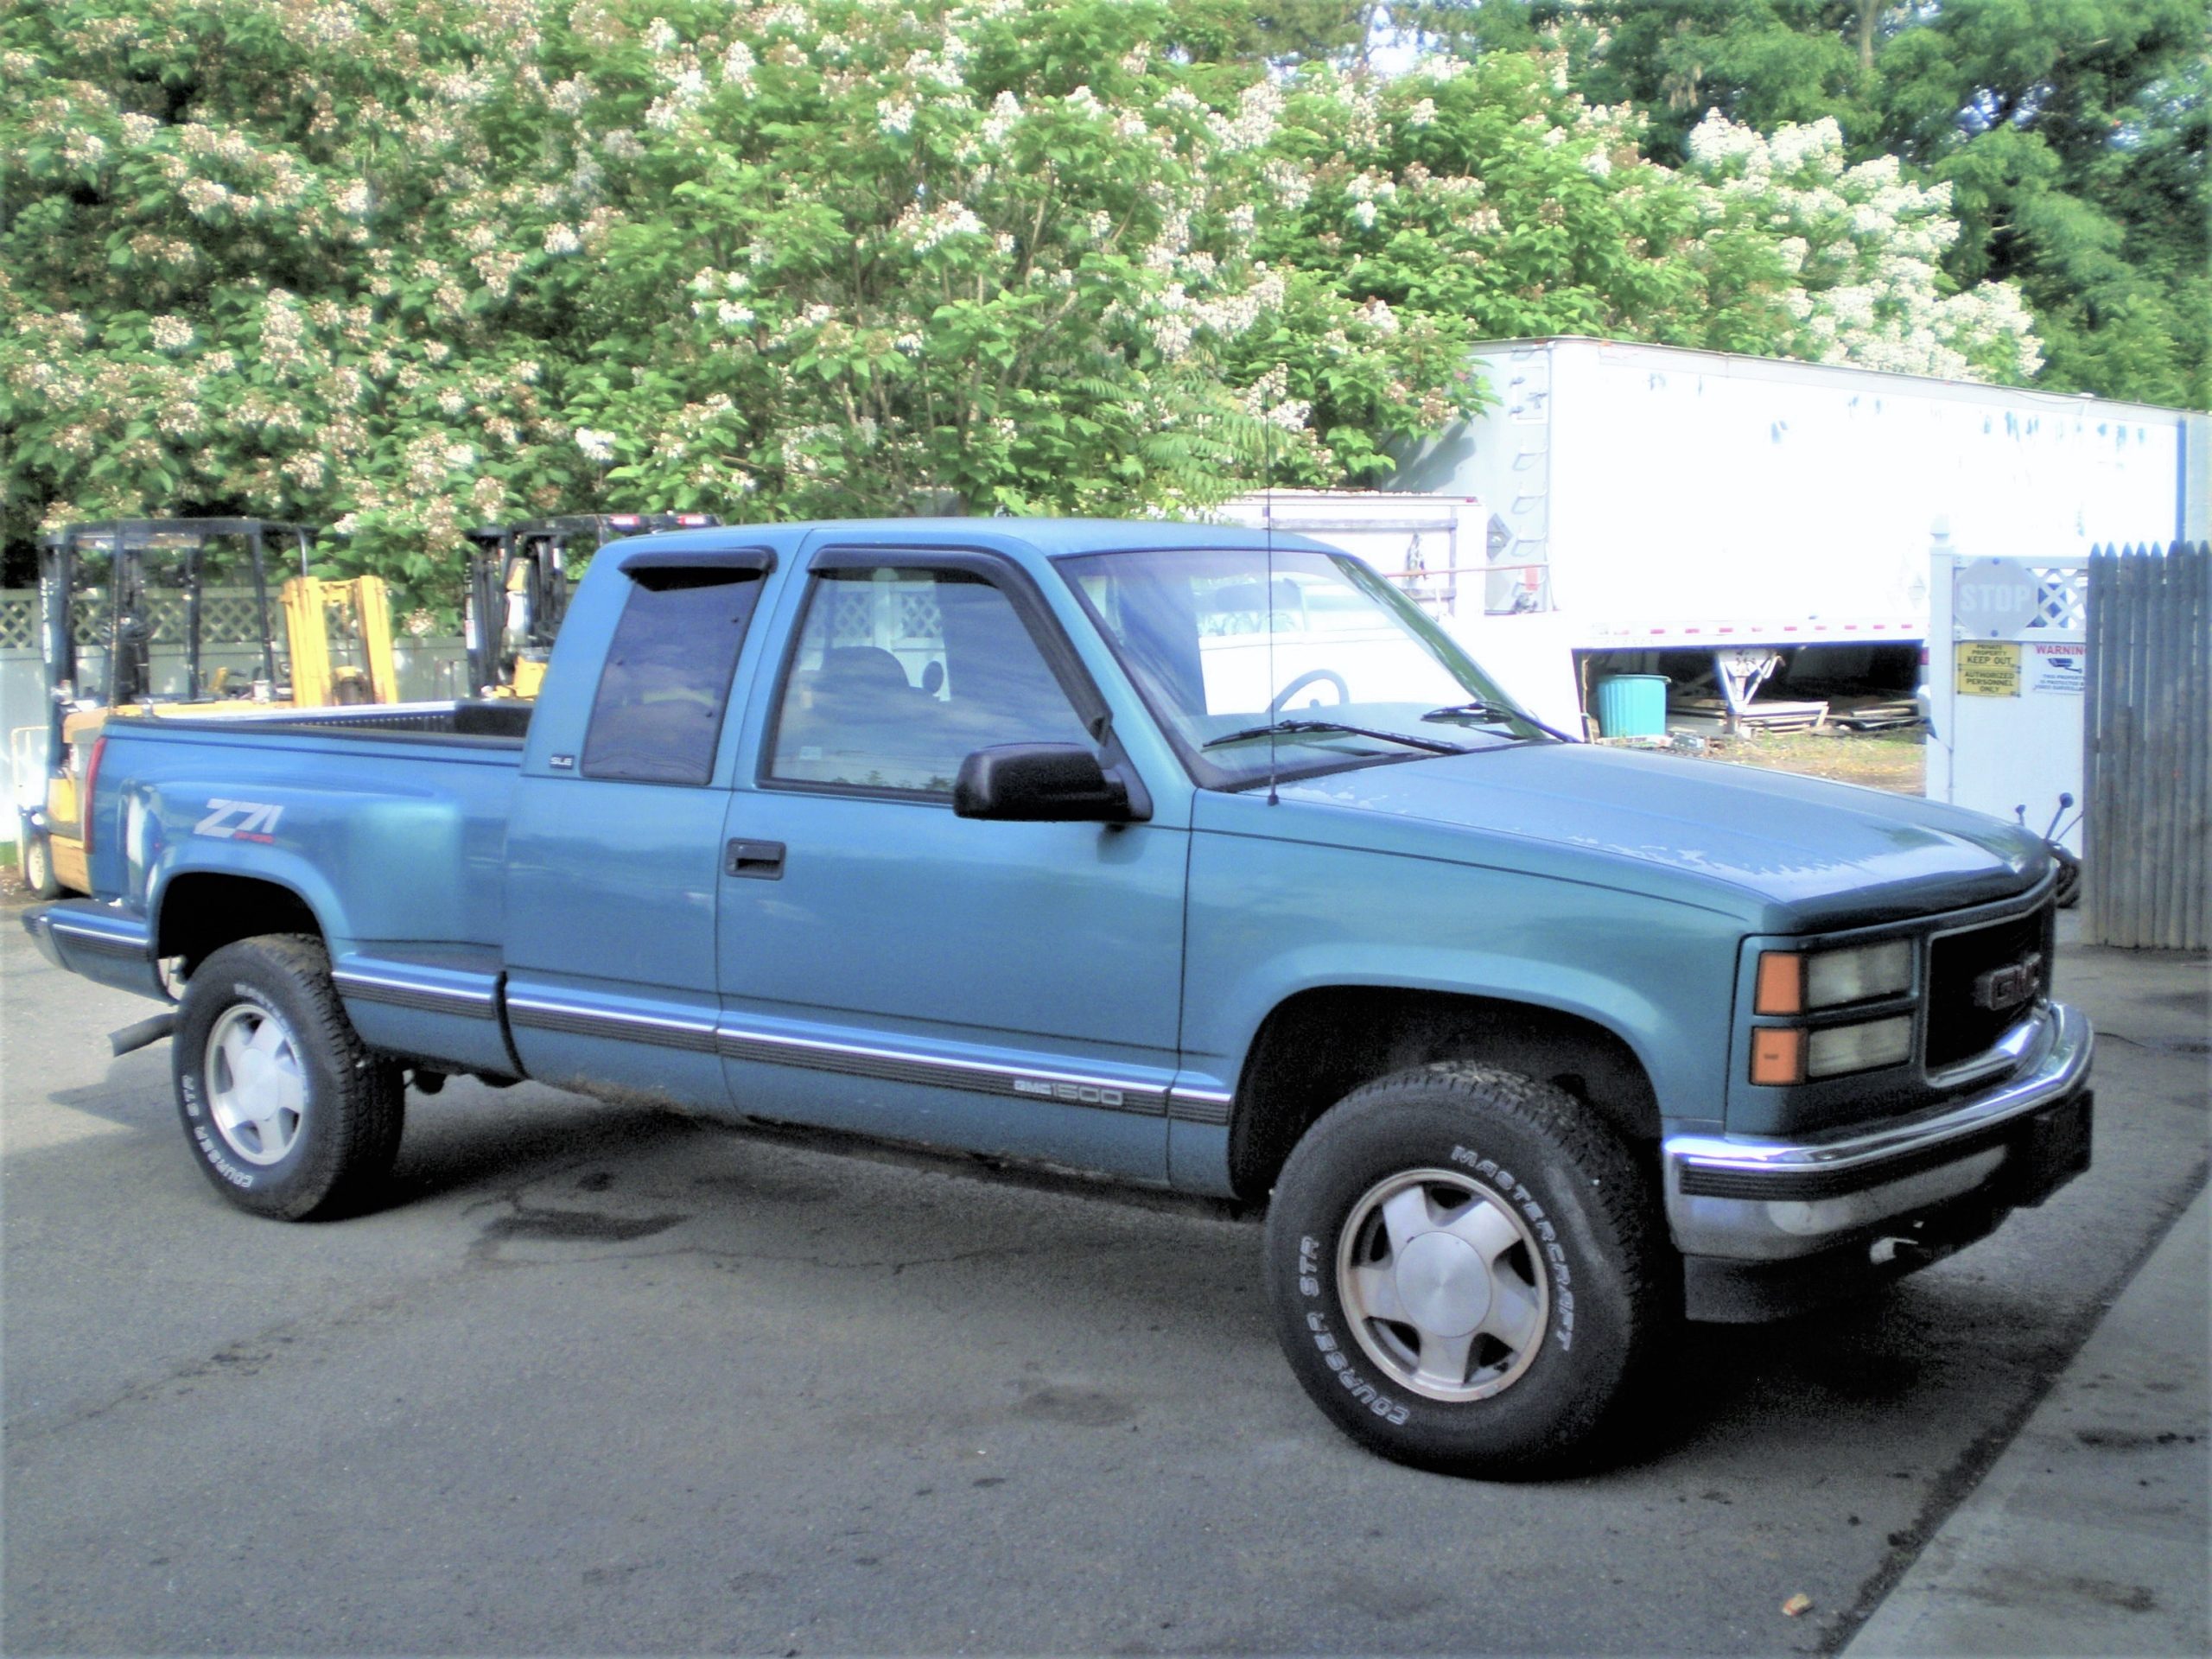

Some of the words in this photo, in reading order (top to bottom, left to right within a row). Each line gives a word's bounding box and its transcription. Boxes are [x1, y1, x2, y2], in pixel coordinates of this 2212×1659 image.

[1960, 583, 2031, 613] STOP
[2036, 645, 2087, 655] WARNIN
[193, 798, 284, 838] Z71
[1989, 952, 2041, 1010] GMC
[1052, 1083, 1122, 1106] 1500
[1450, 1144, 1574, 1352] MASTERCRAFT
[1306, 1312, 1411, 1426] COURSER
